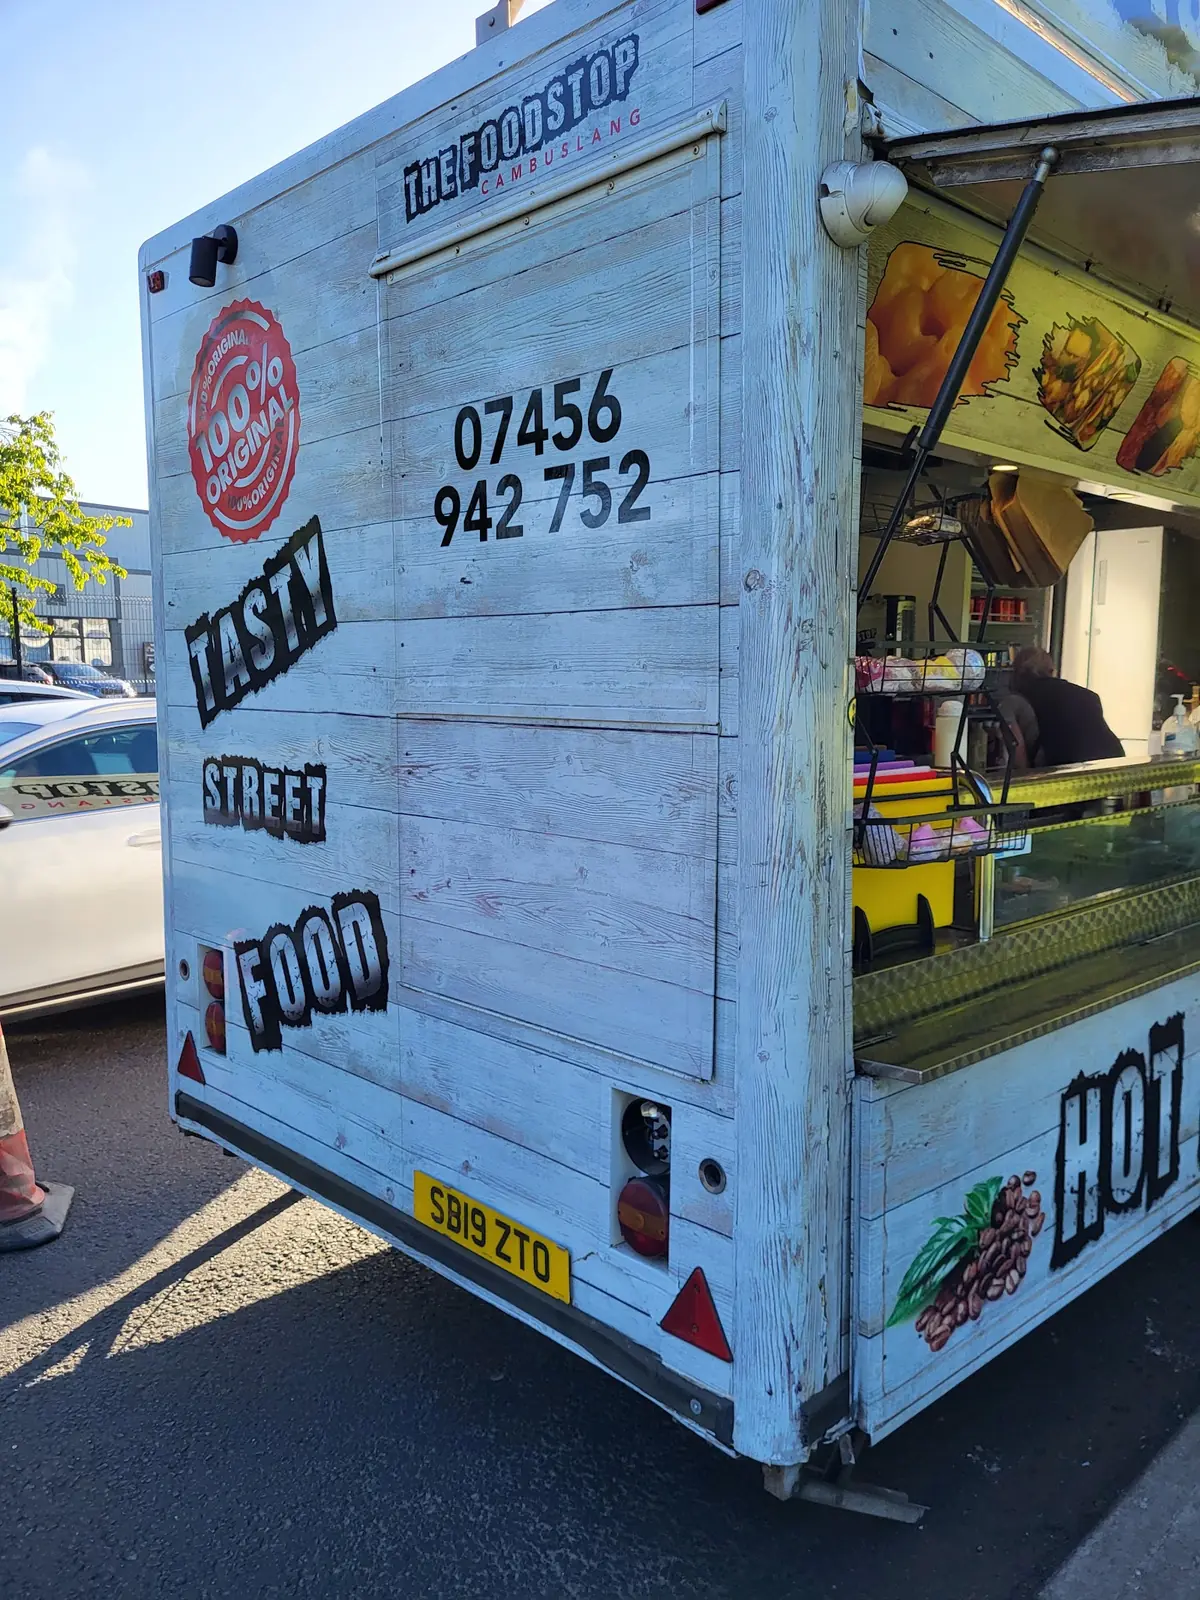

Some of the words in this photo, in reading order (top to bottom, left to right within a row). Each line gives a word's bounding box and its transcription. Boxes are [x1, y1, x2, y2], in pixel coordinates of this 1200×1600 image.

[481, 108, 640, 195] CAMBUSLANG
[195, 343, 284, 473] 100%
[206, 384, 294, 505] ORIGINAL
[454, 368, 622, 470] 07456
[434, 474, 523, 547] 942
[544, 449, 651, 533] 752
[185, 515, 337, 730] TASTY
[203, 754, 326, 844] STREET
[233, 888, 390, 1053] FOOD
[1050, 1011, 1185, 1271] HOT
[430, 1186, 487, 1247] SB19
[495, 1219, 550, 1283] ZTO
